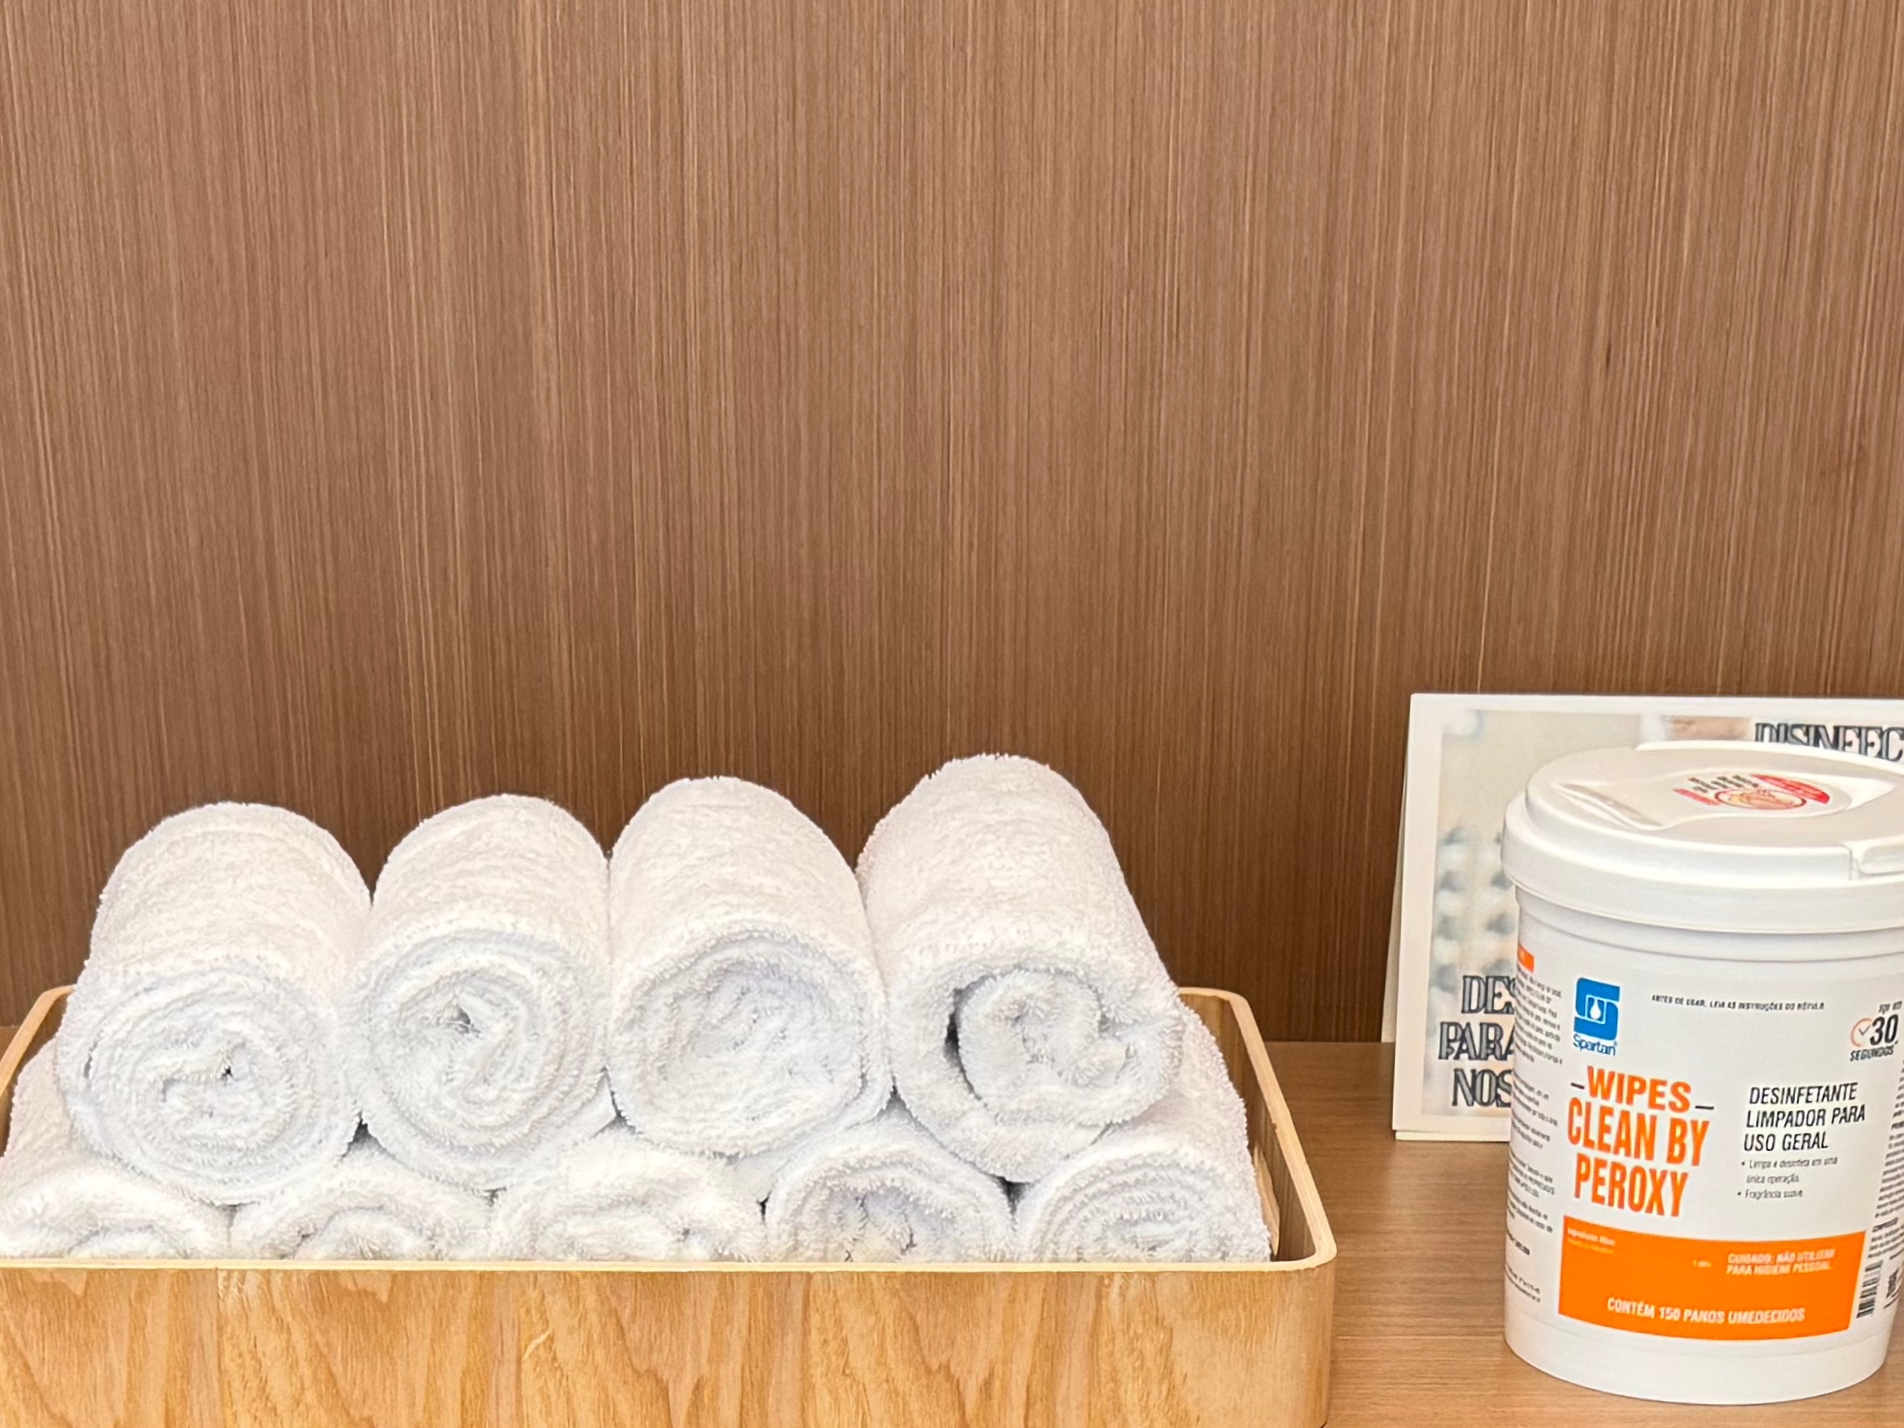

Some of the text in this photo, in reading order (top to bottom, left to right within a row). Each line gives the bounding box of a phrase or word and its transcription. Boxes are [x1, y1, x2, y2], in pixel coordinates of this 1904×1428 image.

[1573, 1033, 1616, 1056] Spartan
[1870, 1014, 1899, 1046] 30
[1586, 1065, 1692, 1114] WIPES
[1749, 1082, 1859, 1105] DESINFETANTE
[1746, 1104, 1866, 1128] LIMPADOR PARA
[1567, 1097, 1658, 1162] CLEAN
[1666, 1117, 1711, 1167] BY
[1743, 1131, 1829, 1152] USO GERAL
[1574, 1152, 1689, 1218] PEROXY
[1607, 1296, 1806, 1325] CONTÉM 150 PANOS UMEDECIDOS
